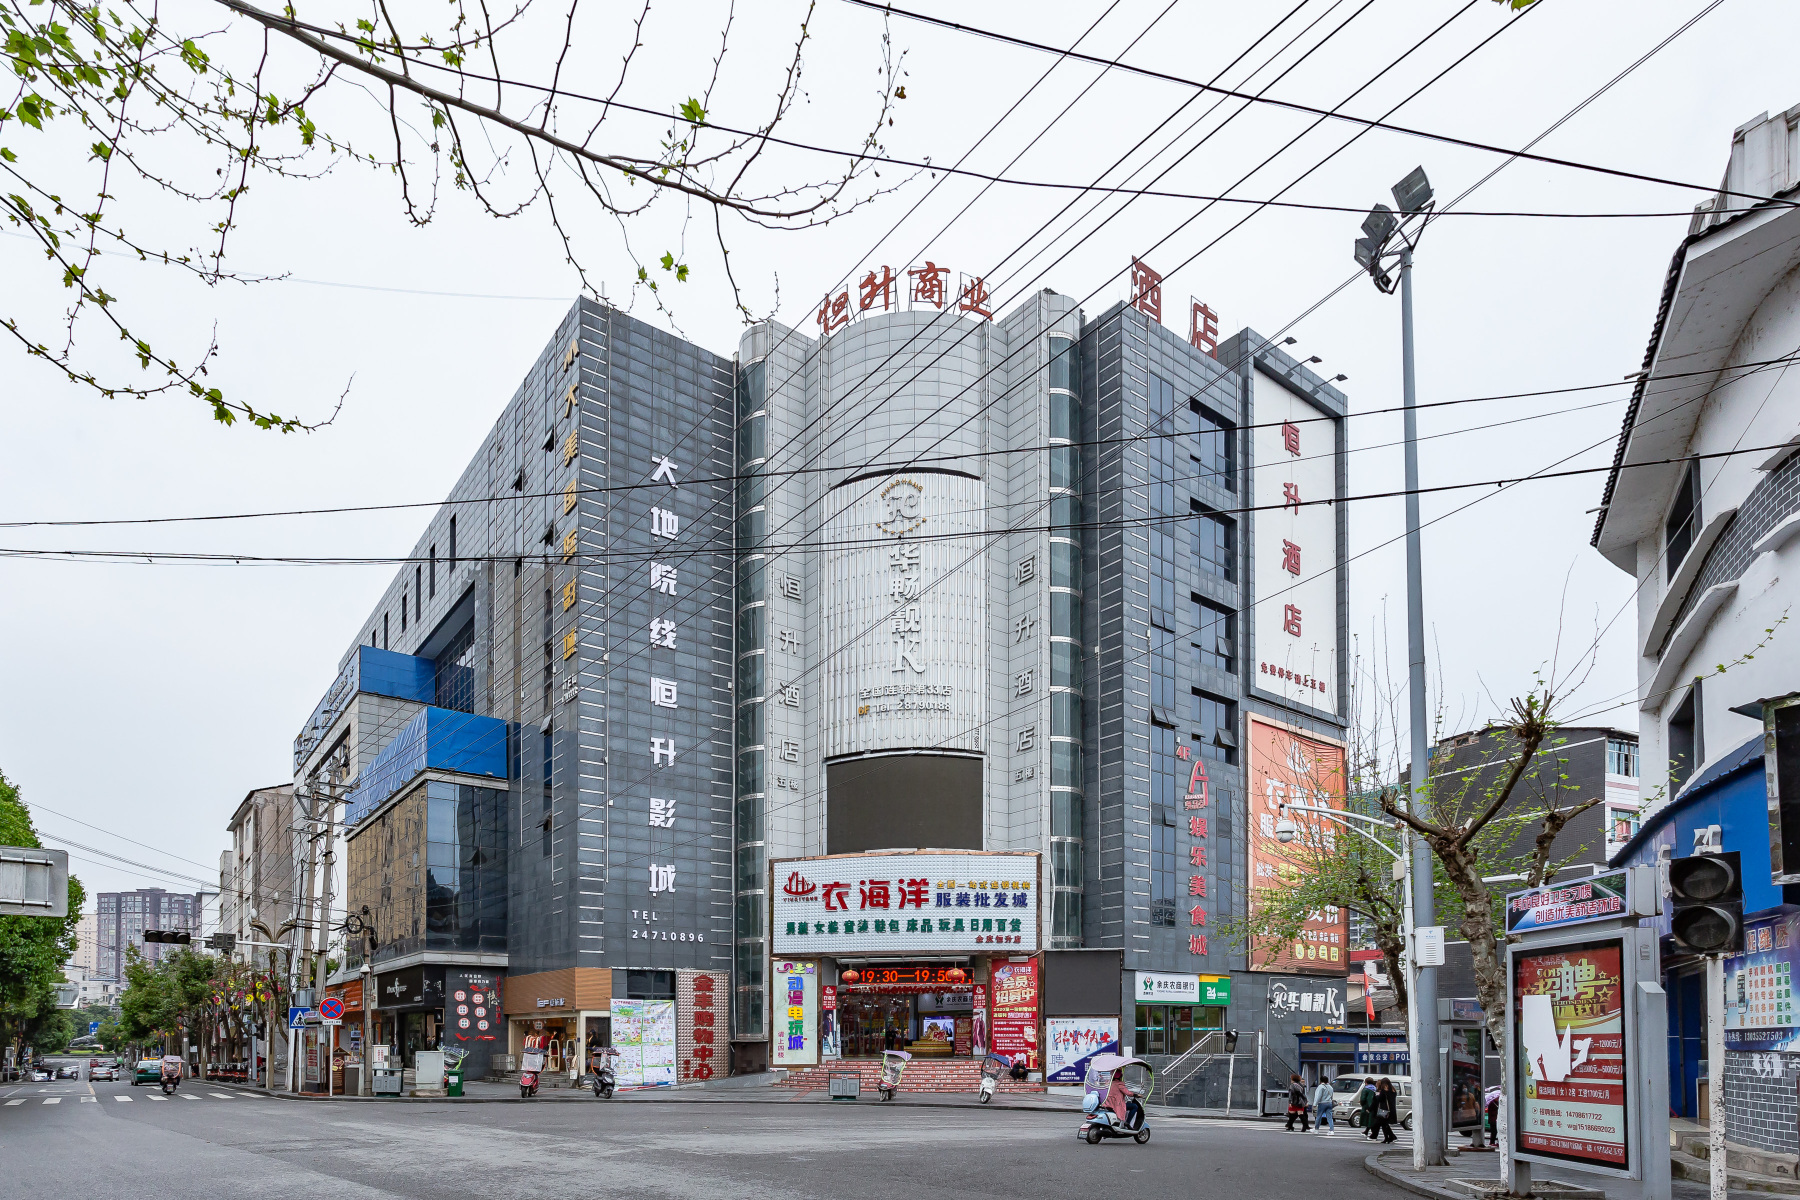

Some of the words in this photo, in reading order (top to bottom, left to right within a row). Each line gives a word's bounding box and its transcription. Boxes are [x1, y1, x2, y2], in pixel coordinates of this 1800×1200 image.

[816, 261, 993, 335] 恒升商业
[1281, 418, 1302, 637] 恒升酒店
[779, 573, 802, 763] 恒升酒店
[1014, 554, 1036, 752] 恒升酒店
[649, 455, 679, 893] 大地院线恒升影城
[858, 705, 870, 716] 6F
[1176, 745, 1191, 760] 4F
[1260, 812, 1336, 852] 服批发城
[822, 879, 930, 912] 衣海洋
[935, 892, 1028, 908] 服装批发城
[937, 880, 1031, 890] 全国一站式连锁机构
[1189, 815, 1209, 956] 娱乐美食城
[1513, 884, 1592, 912] 养成良好卫生习惯
[632, 910, 658, 921] TEL
[1535, 897, 1621, 924] 创造优美舒适环境
[632, 929, 704, 943] 24710896
[786, 921, 809, 935] 男装
[814, 921, 839, 934] 女装
[844, 919, 869, 933] 童装
[874, 919, 900, 933] 鞋包
[906, 918, 933, 933] 床品
[938, 918, 965, 932] 玩具
[970, 918, 1022, 932] 日用百货
[1157, 980, 1195, 991] 余庆农商银行
[1534, 958, 1611, 1002] 招聘
[693, 974, 715, 1079] 金丰购物中心
[787, 976, 804, 1050] 动漫电玩城
[1529, 1084, 1534, 1095] 3
